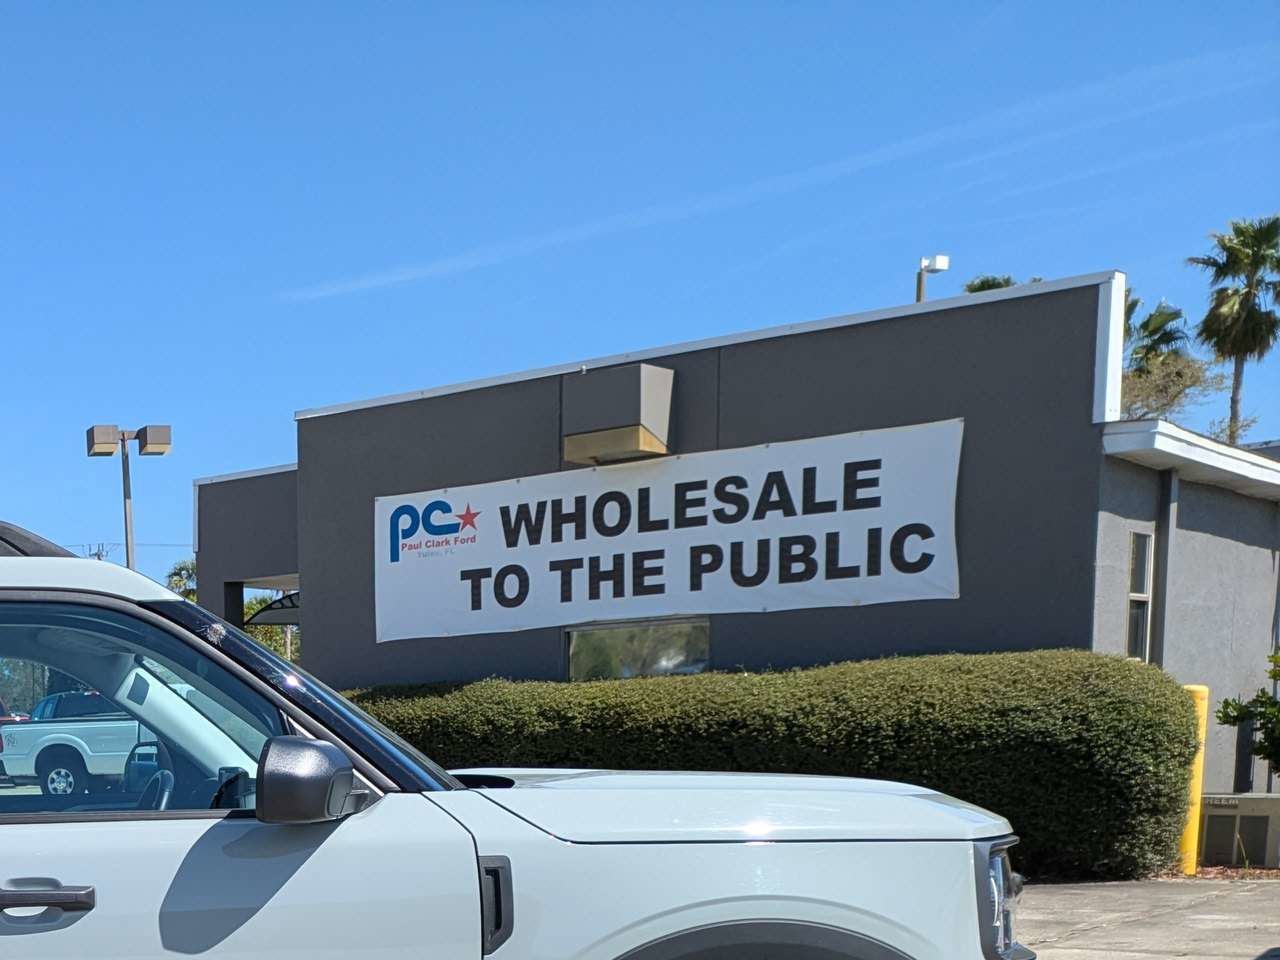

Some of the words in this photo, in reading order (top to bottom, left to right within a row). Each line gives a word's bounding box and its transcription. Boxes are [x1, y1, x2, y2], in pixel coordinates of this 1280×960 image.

[400, 539, 422, 552] Paul
[424, 537, 451, 550] Clark
[453, 534, 476, 546] Ford
[499, 458, 882, 548] WHOLESALE
[460, 563, 530, 608] TO
[549, 549, 665, 603] THE
[689, 522, 935, 592] PUBLIC
